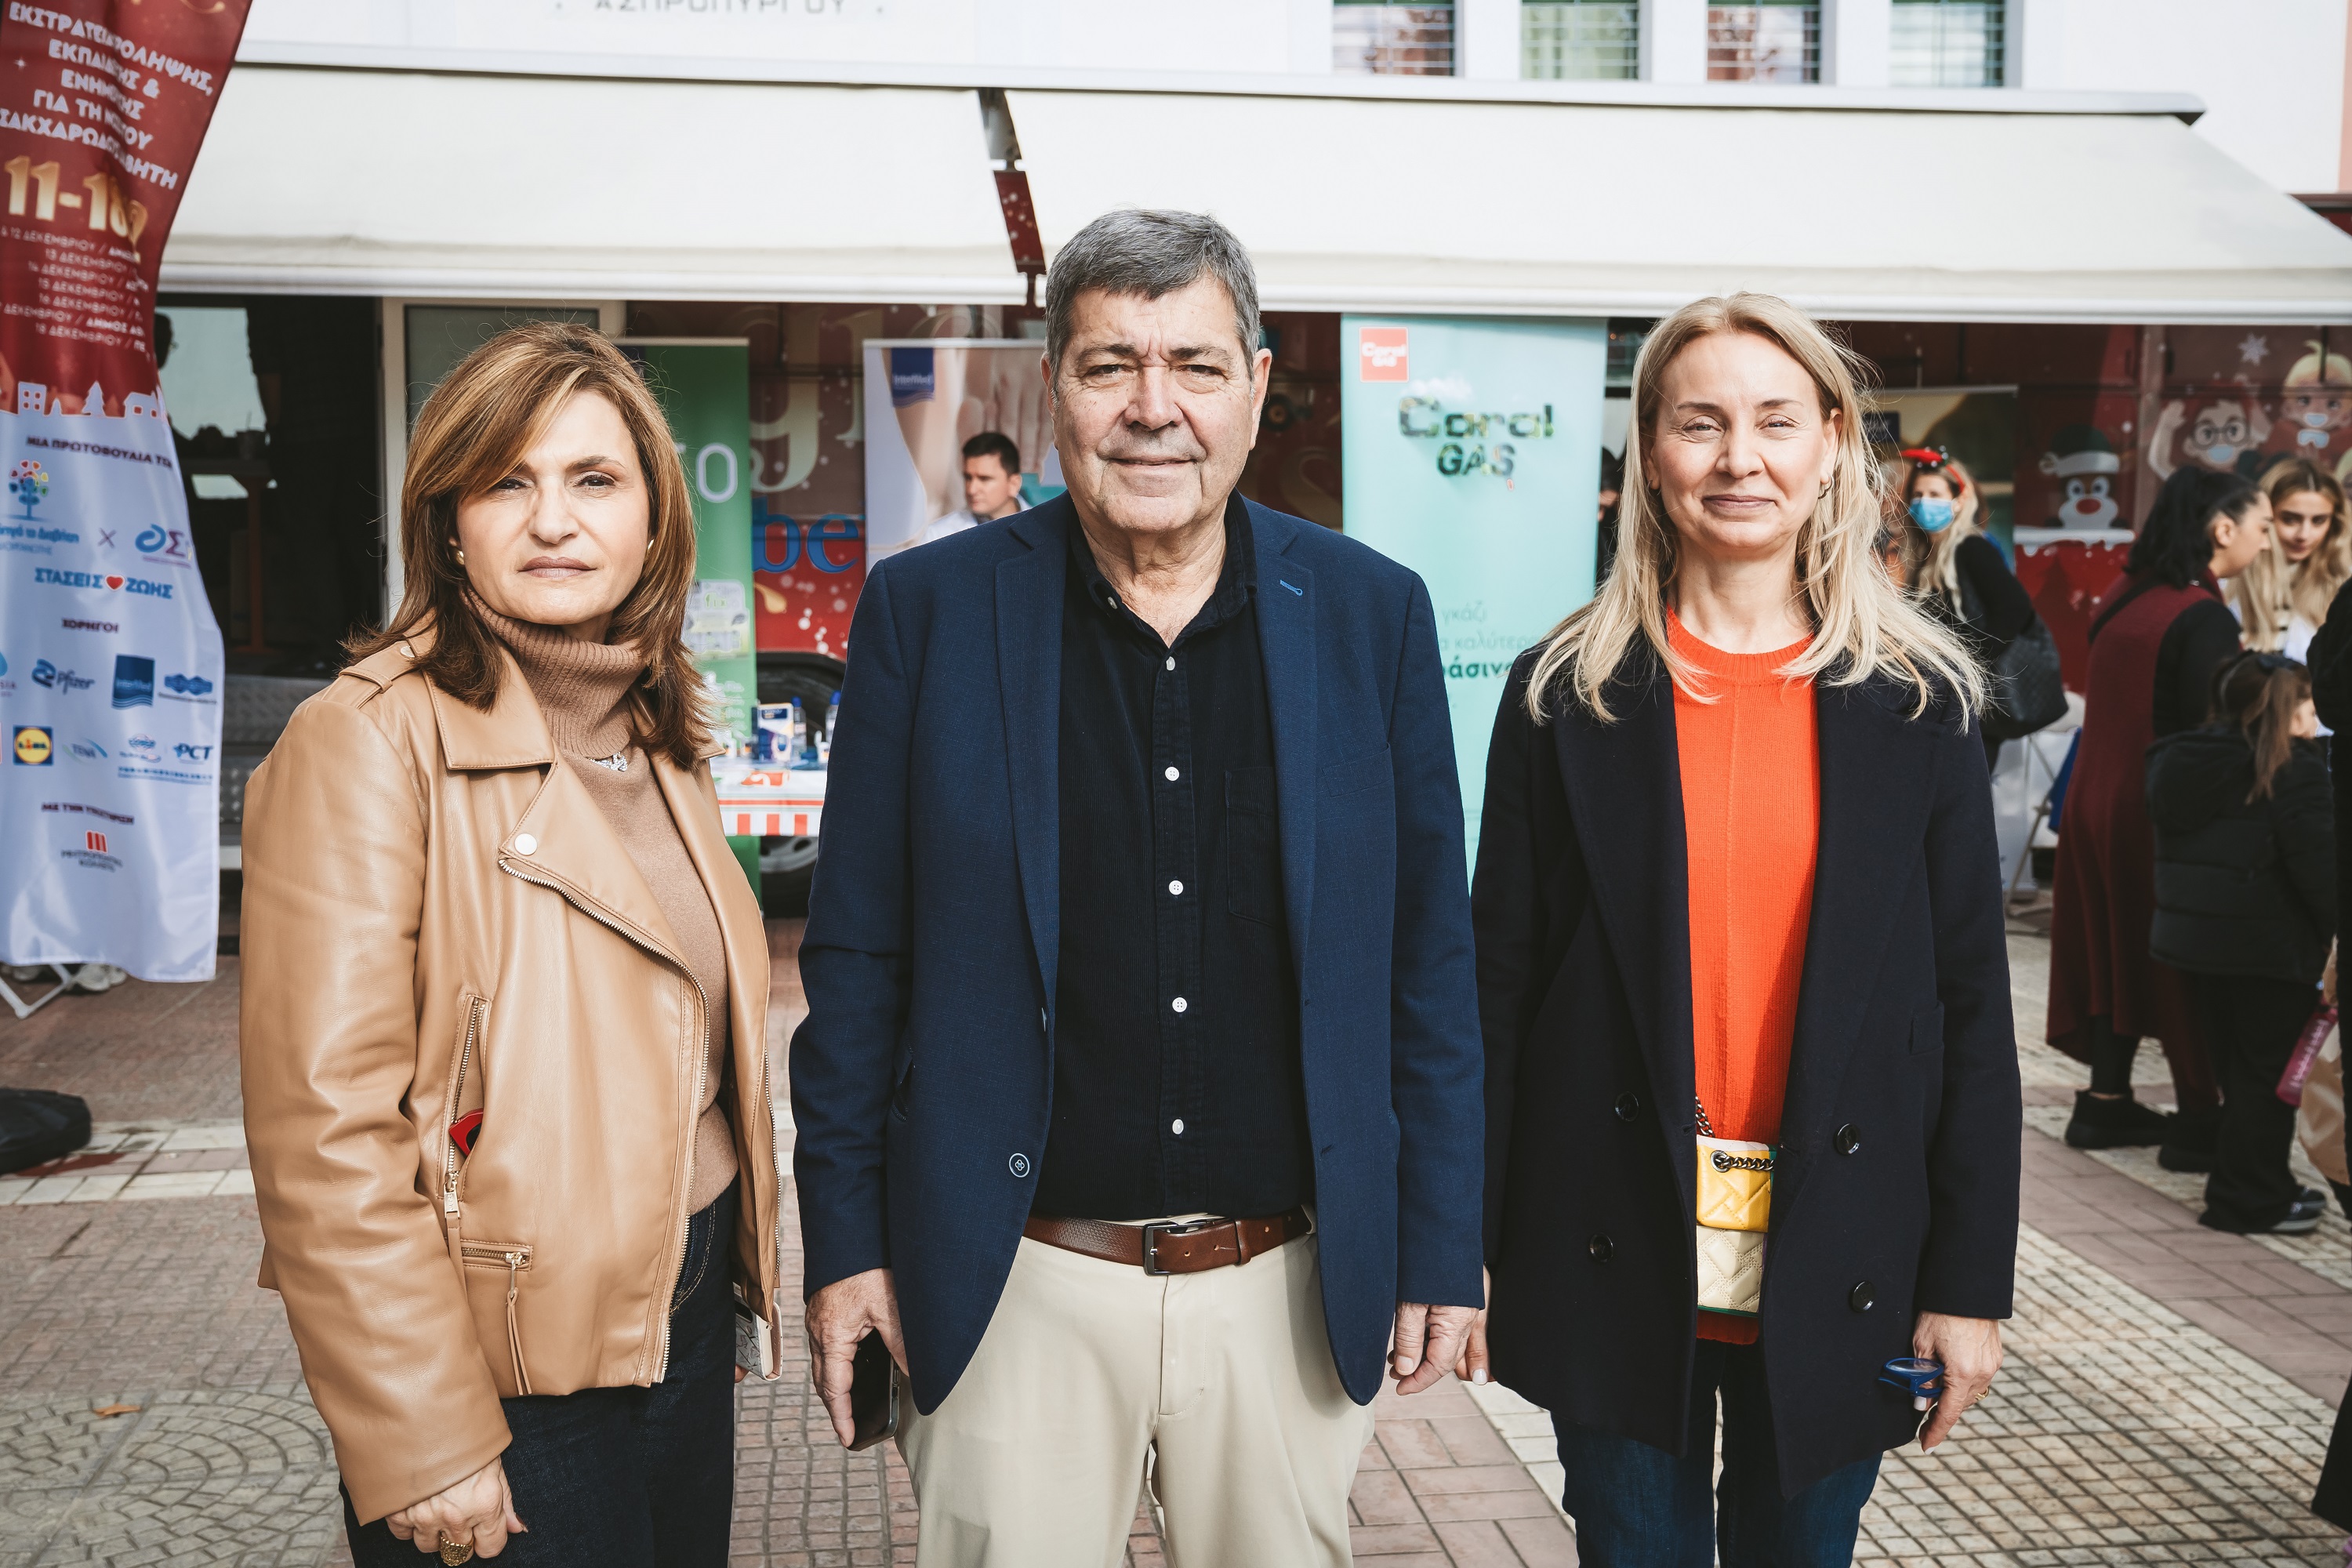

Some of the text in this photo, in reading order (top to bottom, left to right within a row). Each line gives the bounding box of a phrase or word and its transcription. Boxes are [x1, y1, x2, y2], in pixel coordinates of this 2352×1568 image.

[143, 78, 160, 99] &
[34, 89, 69, 114] ΓΙΑ
[75, 97, 102, 122] ΤΗ
[1361, 341, 1406, 358] Coral
[1399, 395, 1555, 438] Coral
[27, 435, 49, 448] ΜΙΑ
[52, 438, 153, 465] ΠΡΩΤΟΒΟΥΛΙΑ
[1437, 441, 1515, 477] GAS
[34, 566, 174, 600] ΣΤΑΣΕΙΣ ΖΩΗΣ
[1441, 599, 1488, 625] γκάζι
[1442, 655, 1515, 680] άσιν
